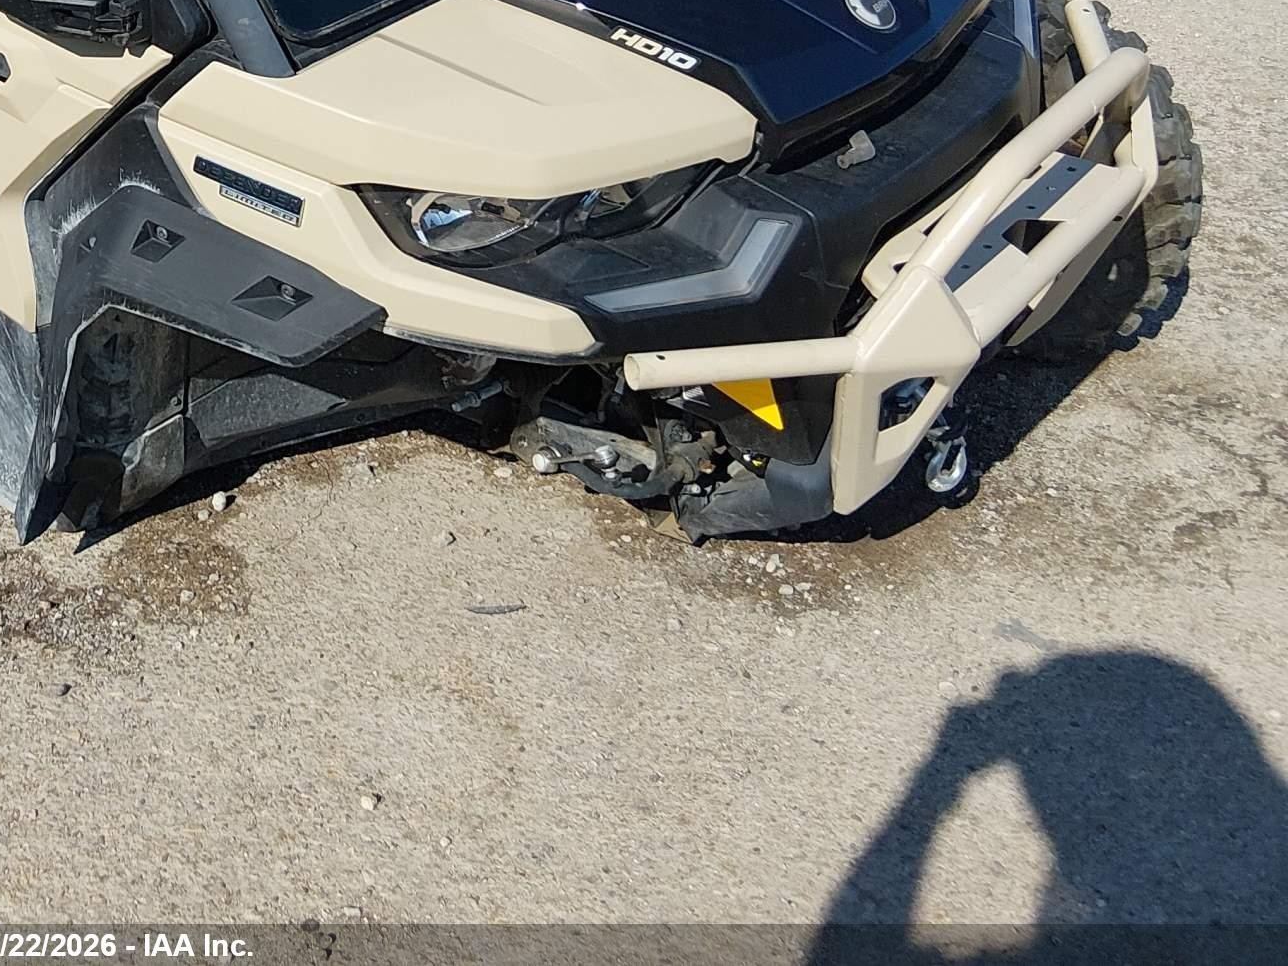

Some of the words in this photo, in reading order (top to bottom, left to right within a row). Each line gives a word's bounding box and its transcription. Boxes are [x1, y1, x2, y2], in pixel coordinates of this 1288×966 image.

[610, 28, 697, 69] HD10
[196, 159, 300, 213] DEFENDER
[223, 187, 296, 223] LIMITED
